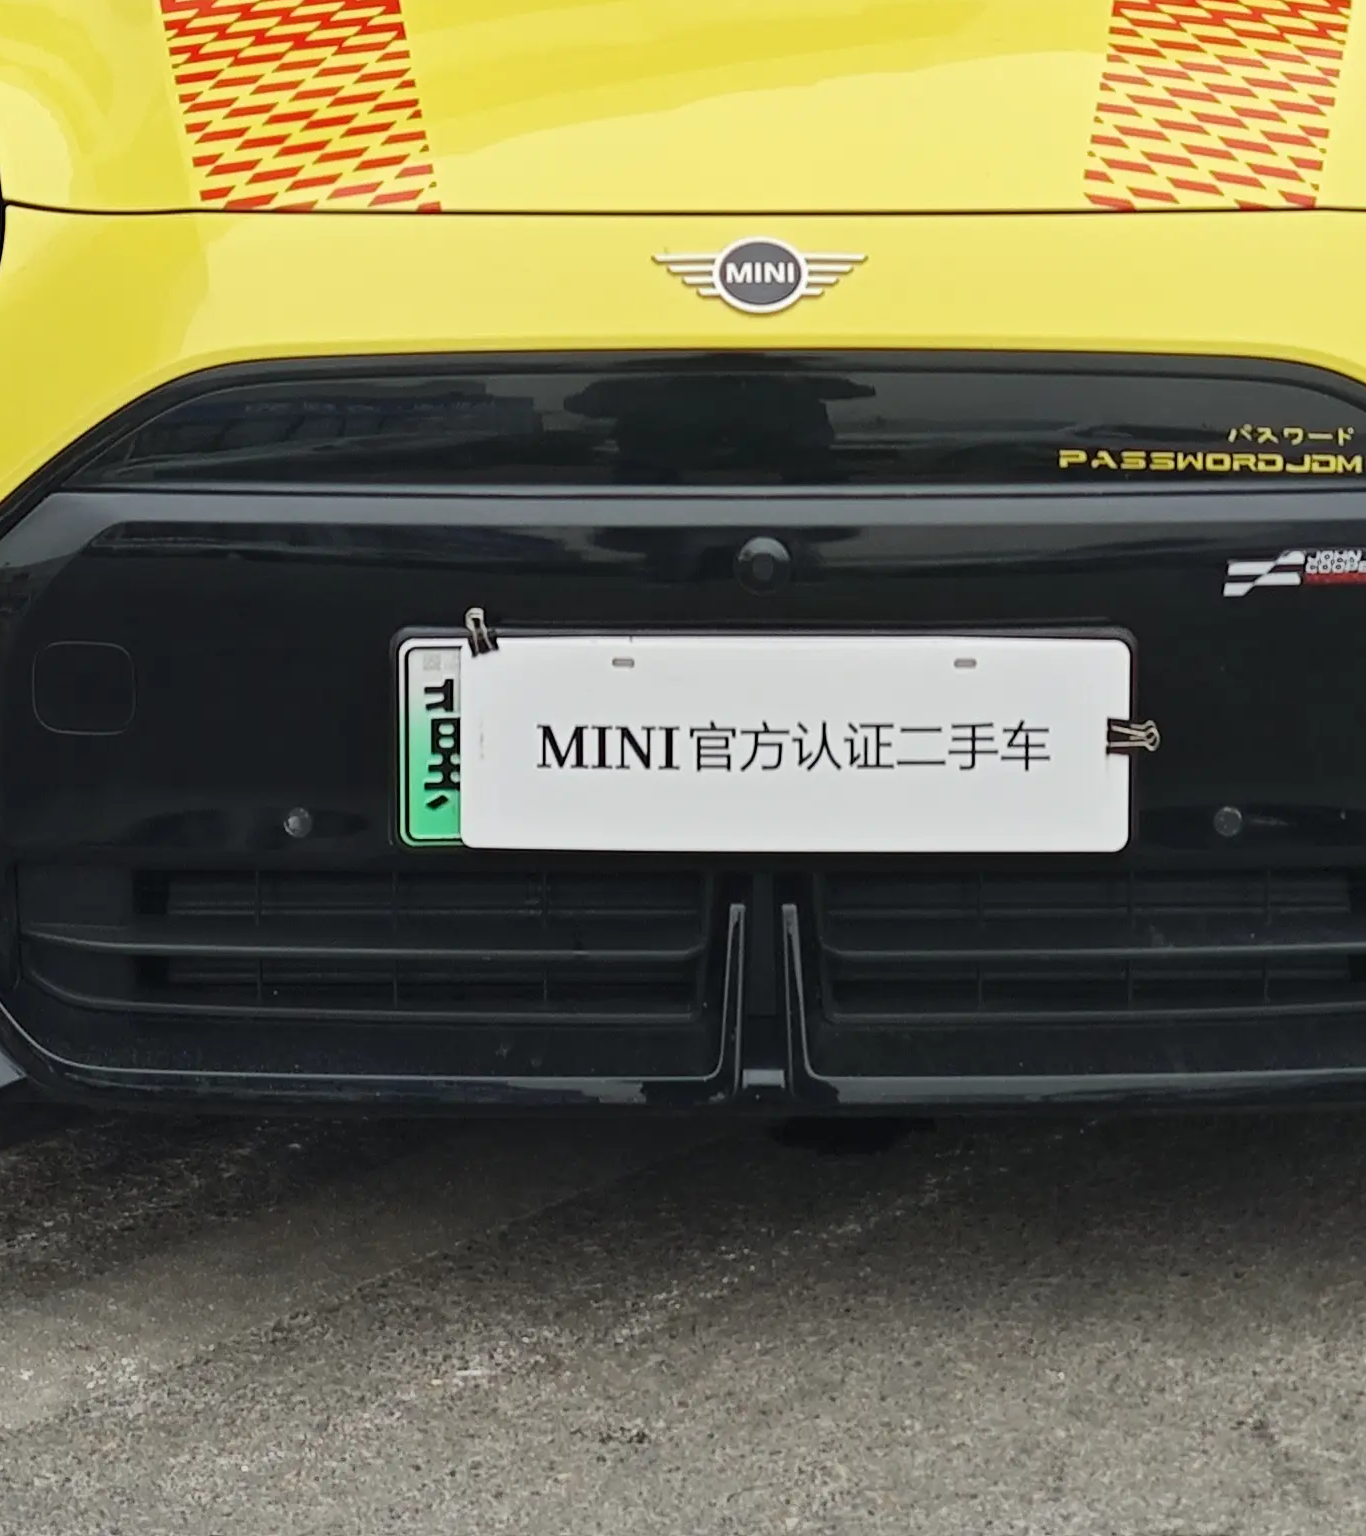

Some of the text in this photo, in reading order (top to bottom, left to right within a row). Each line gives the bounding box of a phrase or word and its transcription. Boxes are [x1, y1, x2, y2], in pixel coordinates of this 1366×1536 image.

[725, 261, 795, 285] MINI
[1227, 423, 1356, 448] パスワード
[1307, 549, 1363, 563] JOHN
